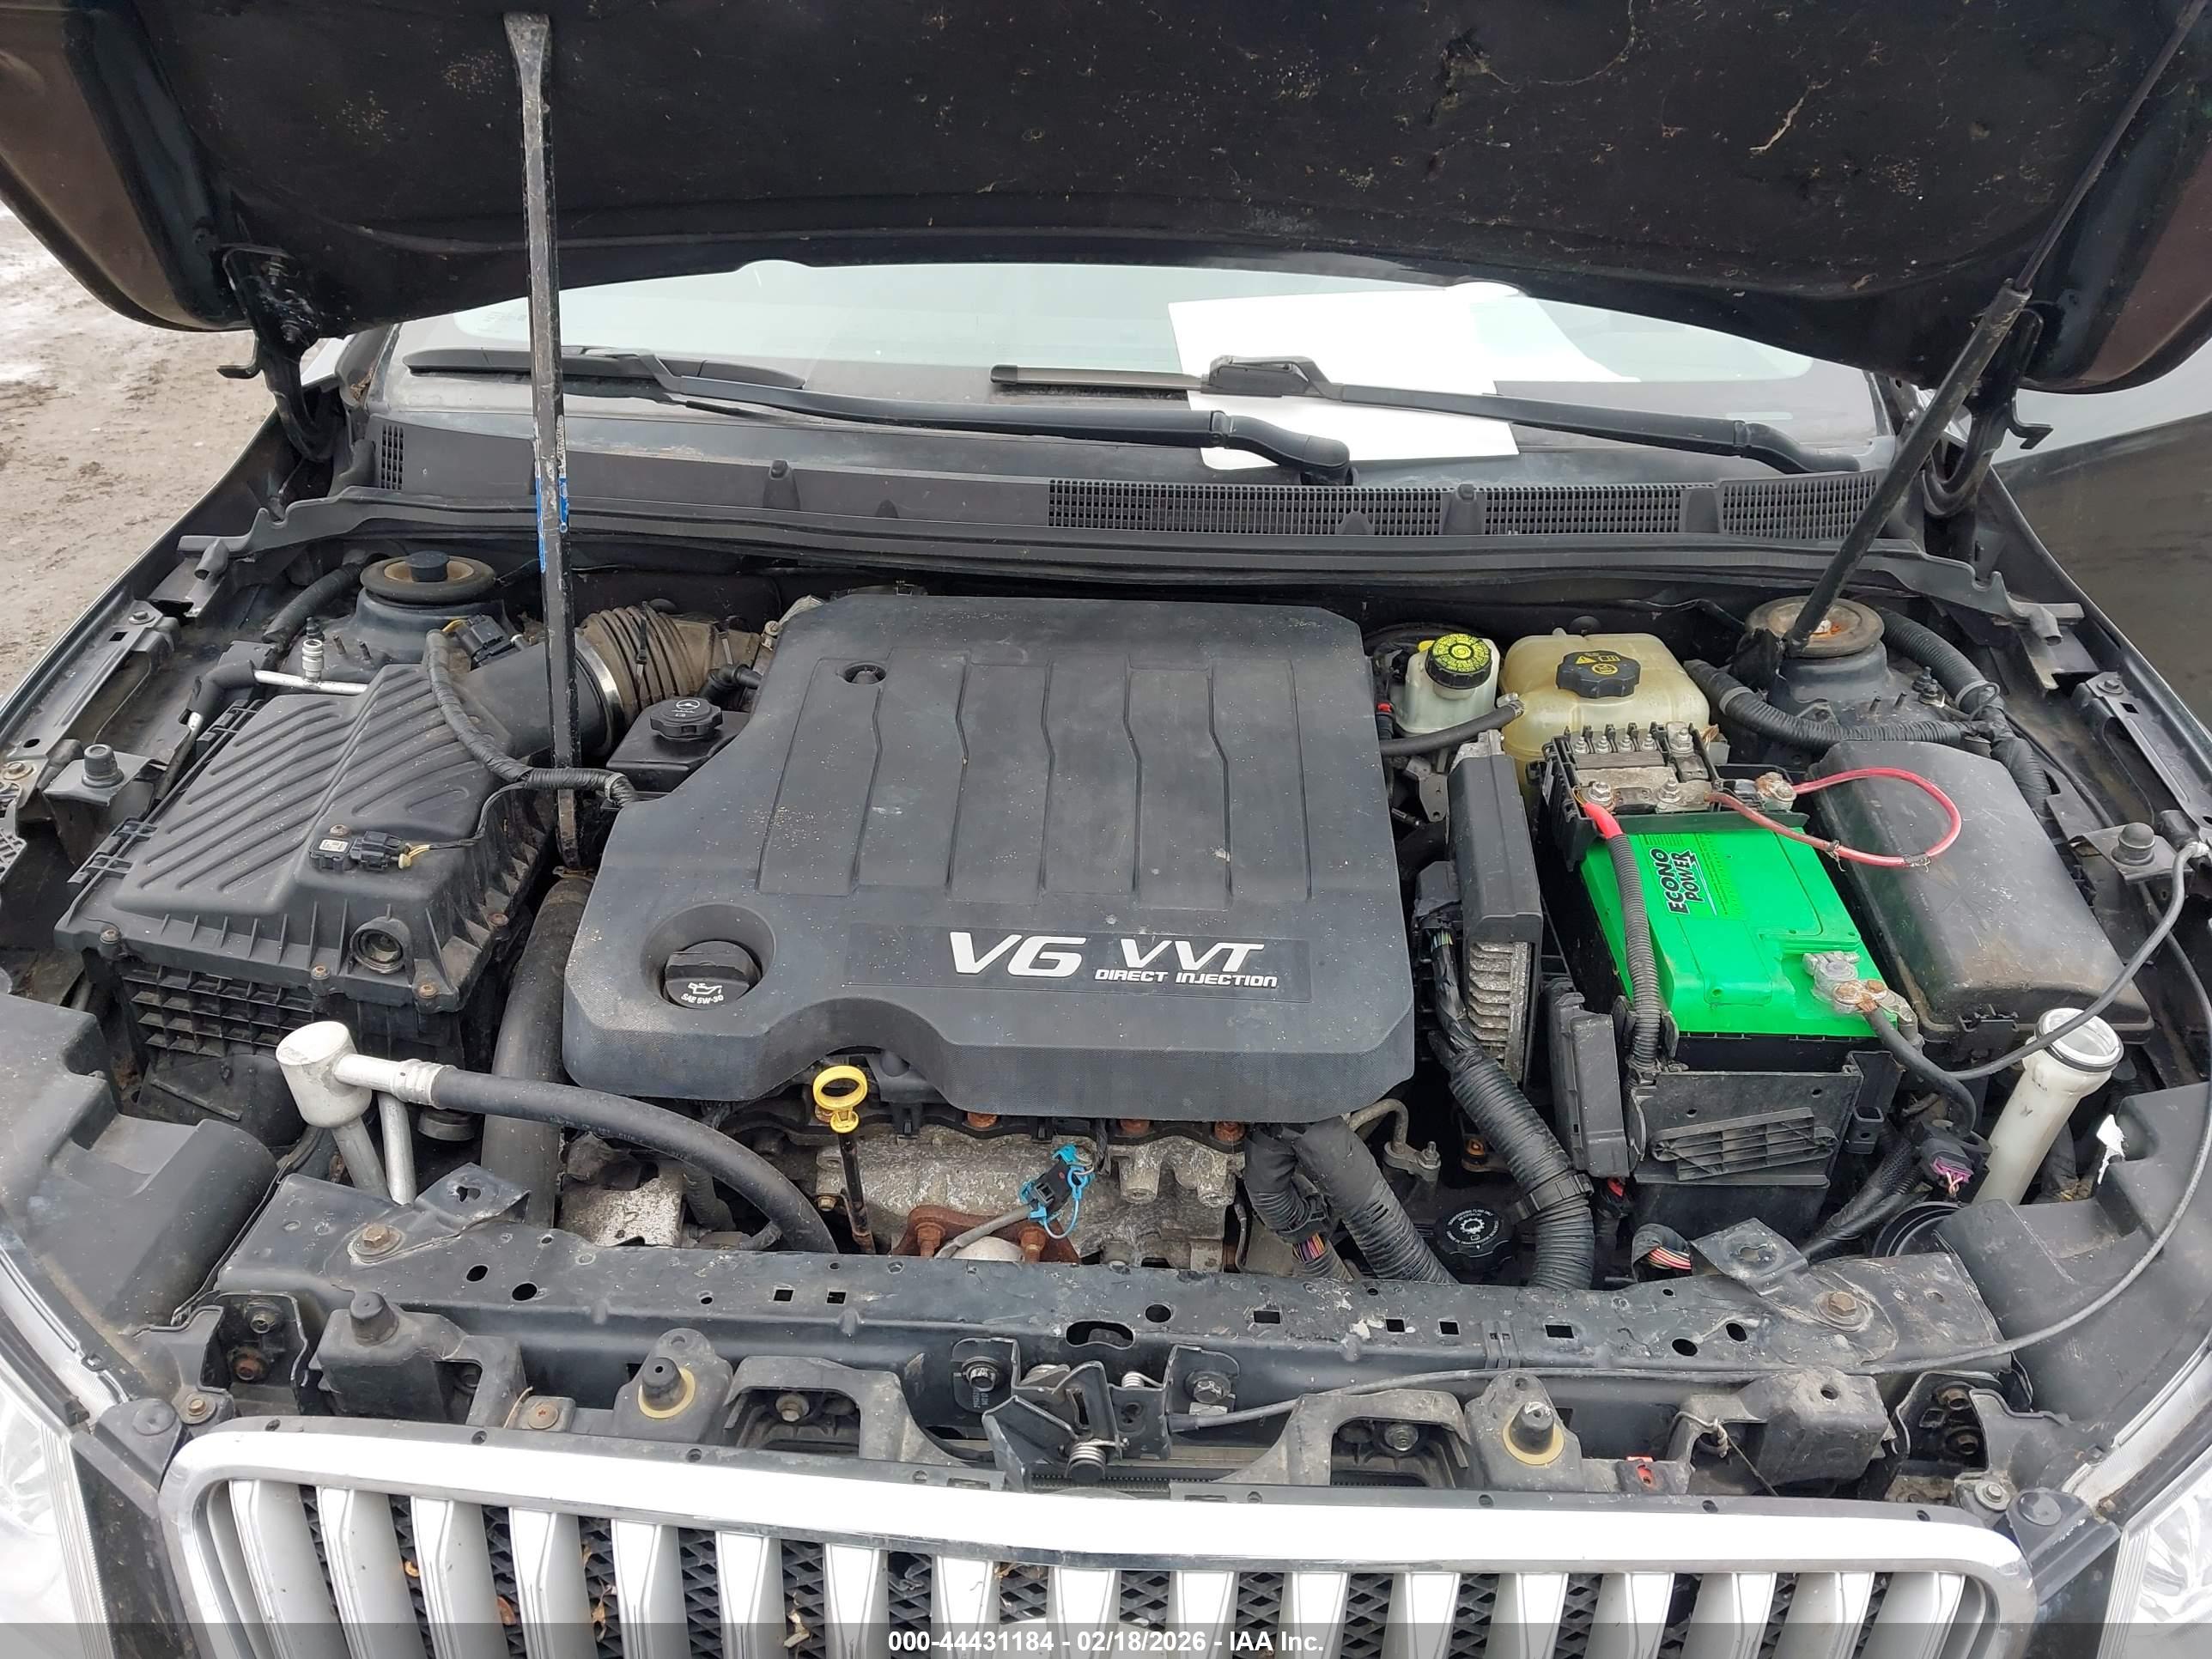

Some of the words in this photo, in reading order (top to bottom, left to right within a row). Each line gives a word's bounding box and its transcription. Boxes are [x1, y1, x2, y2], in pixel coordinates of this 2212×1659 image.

[1650, 848, 1690, 915] ECONO
[1670, 849, 1705, 902] POWER
[950, 932, 1087, 978] V6
[1121, 938, 1265, 973] VVT
[1095, 969, 1168, 983] DIRECT
[1176, 972, 1277, 988] INJECTION
